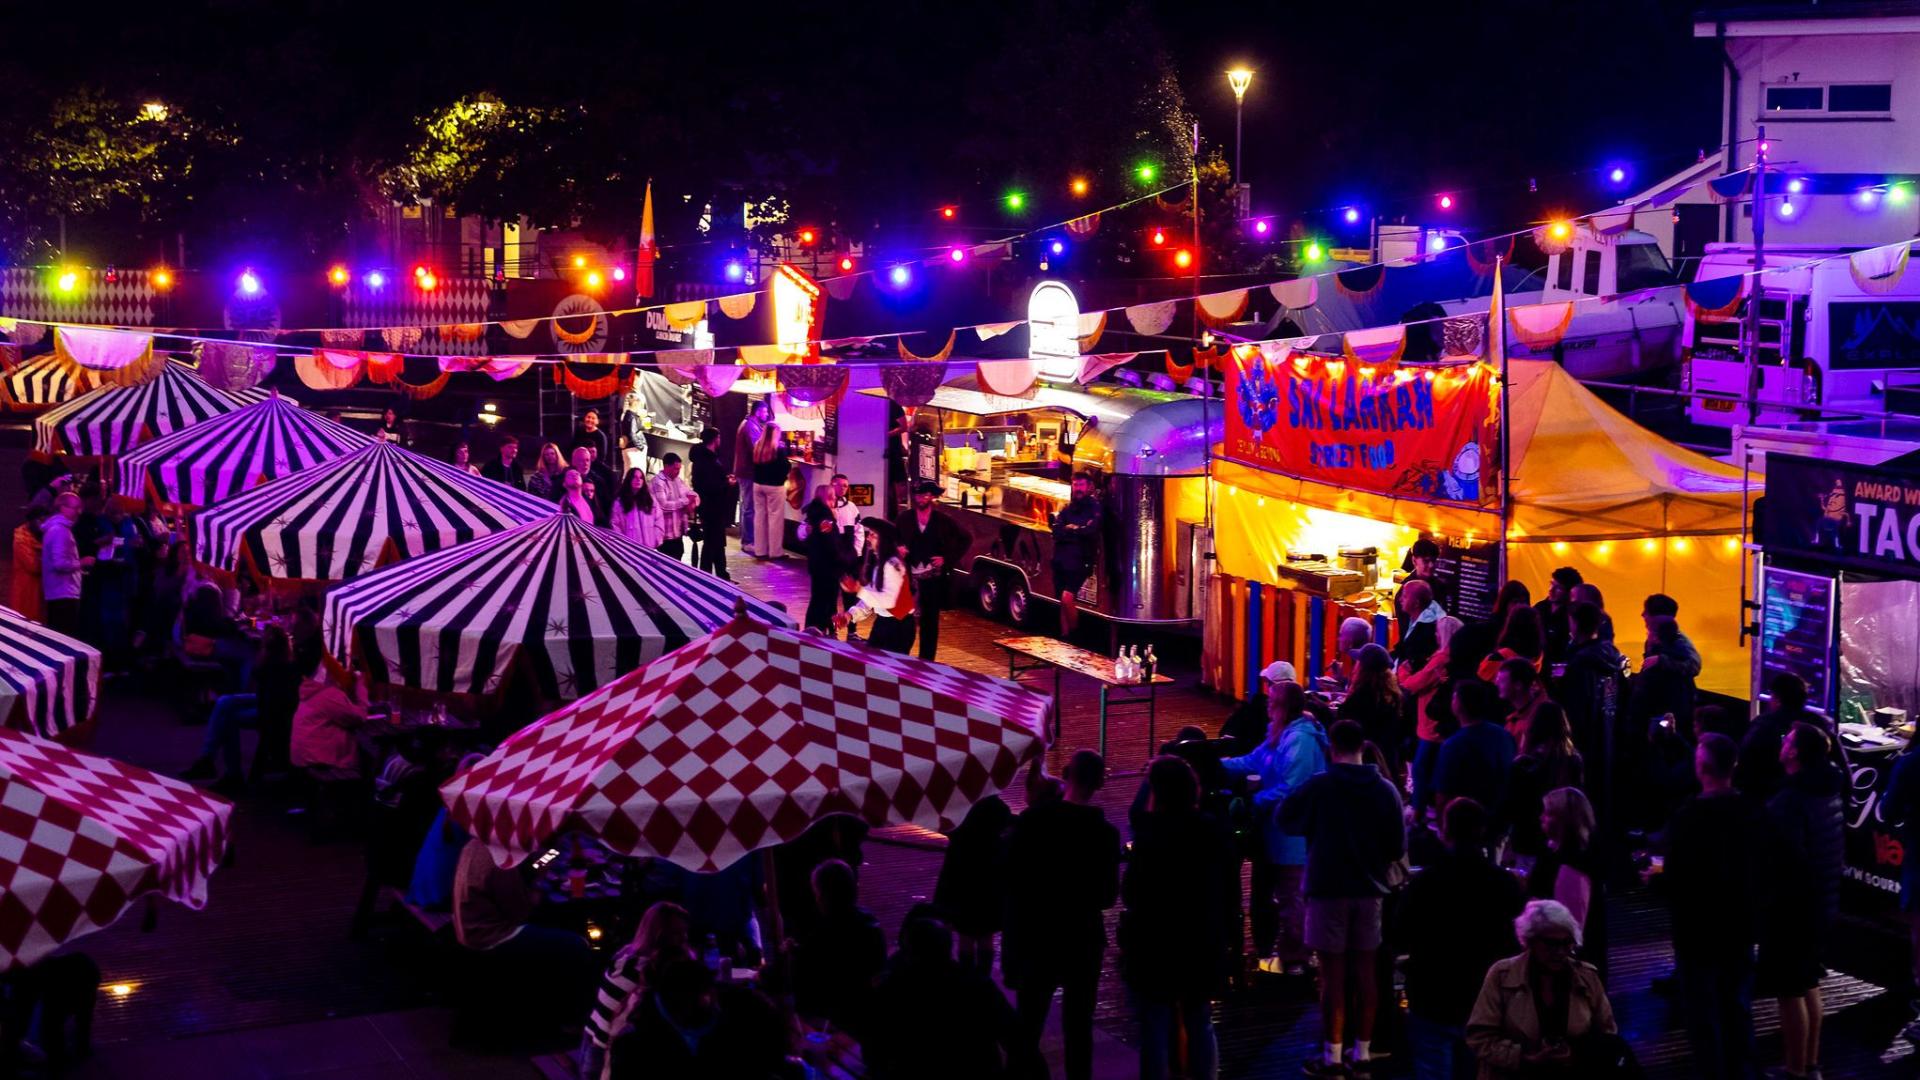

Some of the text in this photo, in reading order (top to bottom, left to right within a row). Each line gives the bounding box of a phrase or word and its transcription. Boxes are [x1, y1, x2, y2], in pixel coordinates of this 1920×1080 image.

[1288, 376, 1435, 432] SRI LANKAN
[1310, 441, 1354, 470] STREET
[1360, 440, 1396, 471] FOOD
[1854, 481, 1902, 504] AWARD
